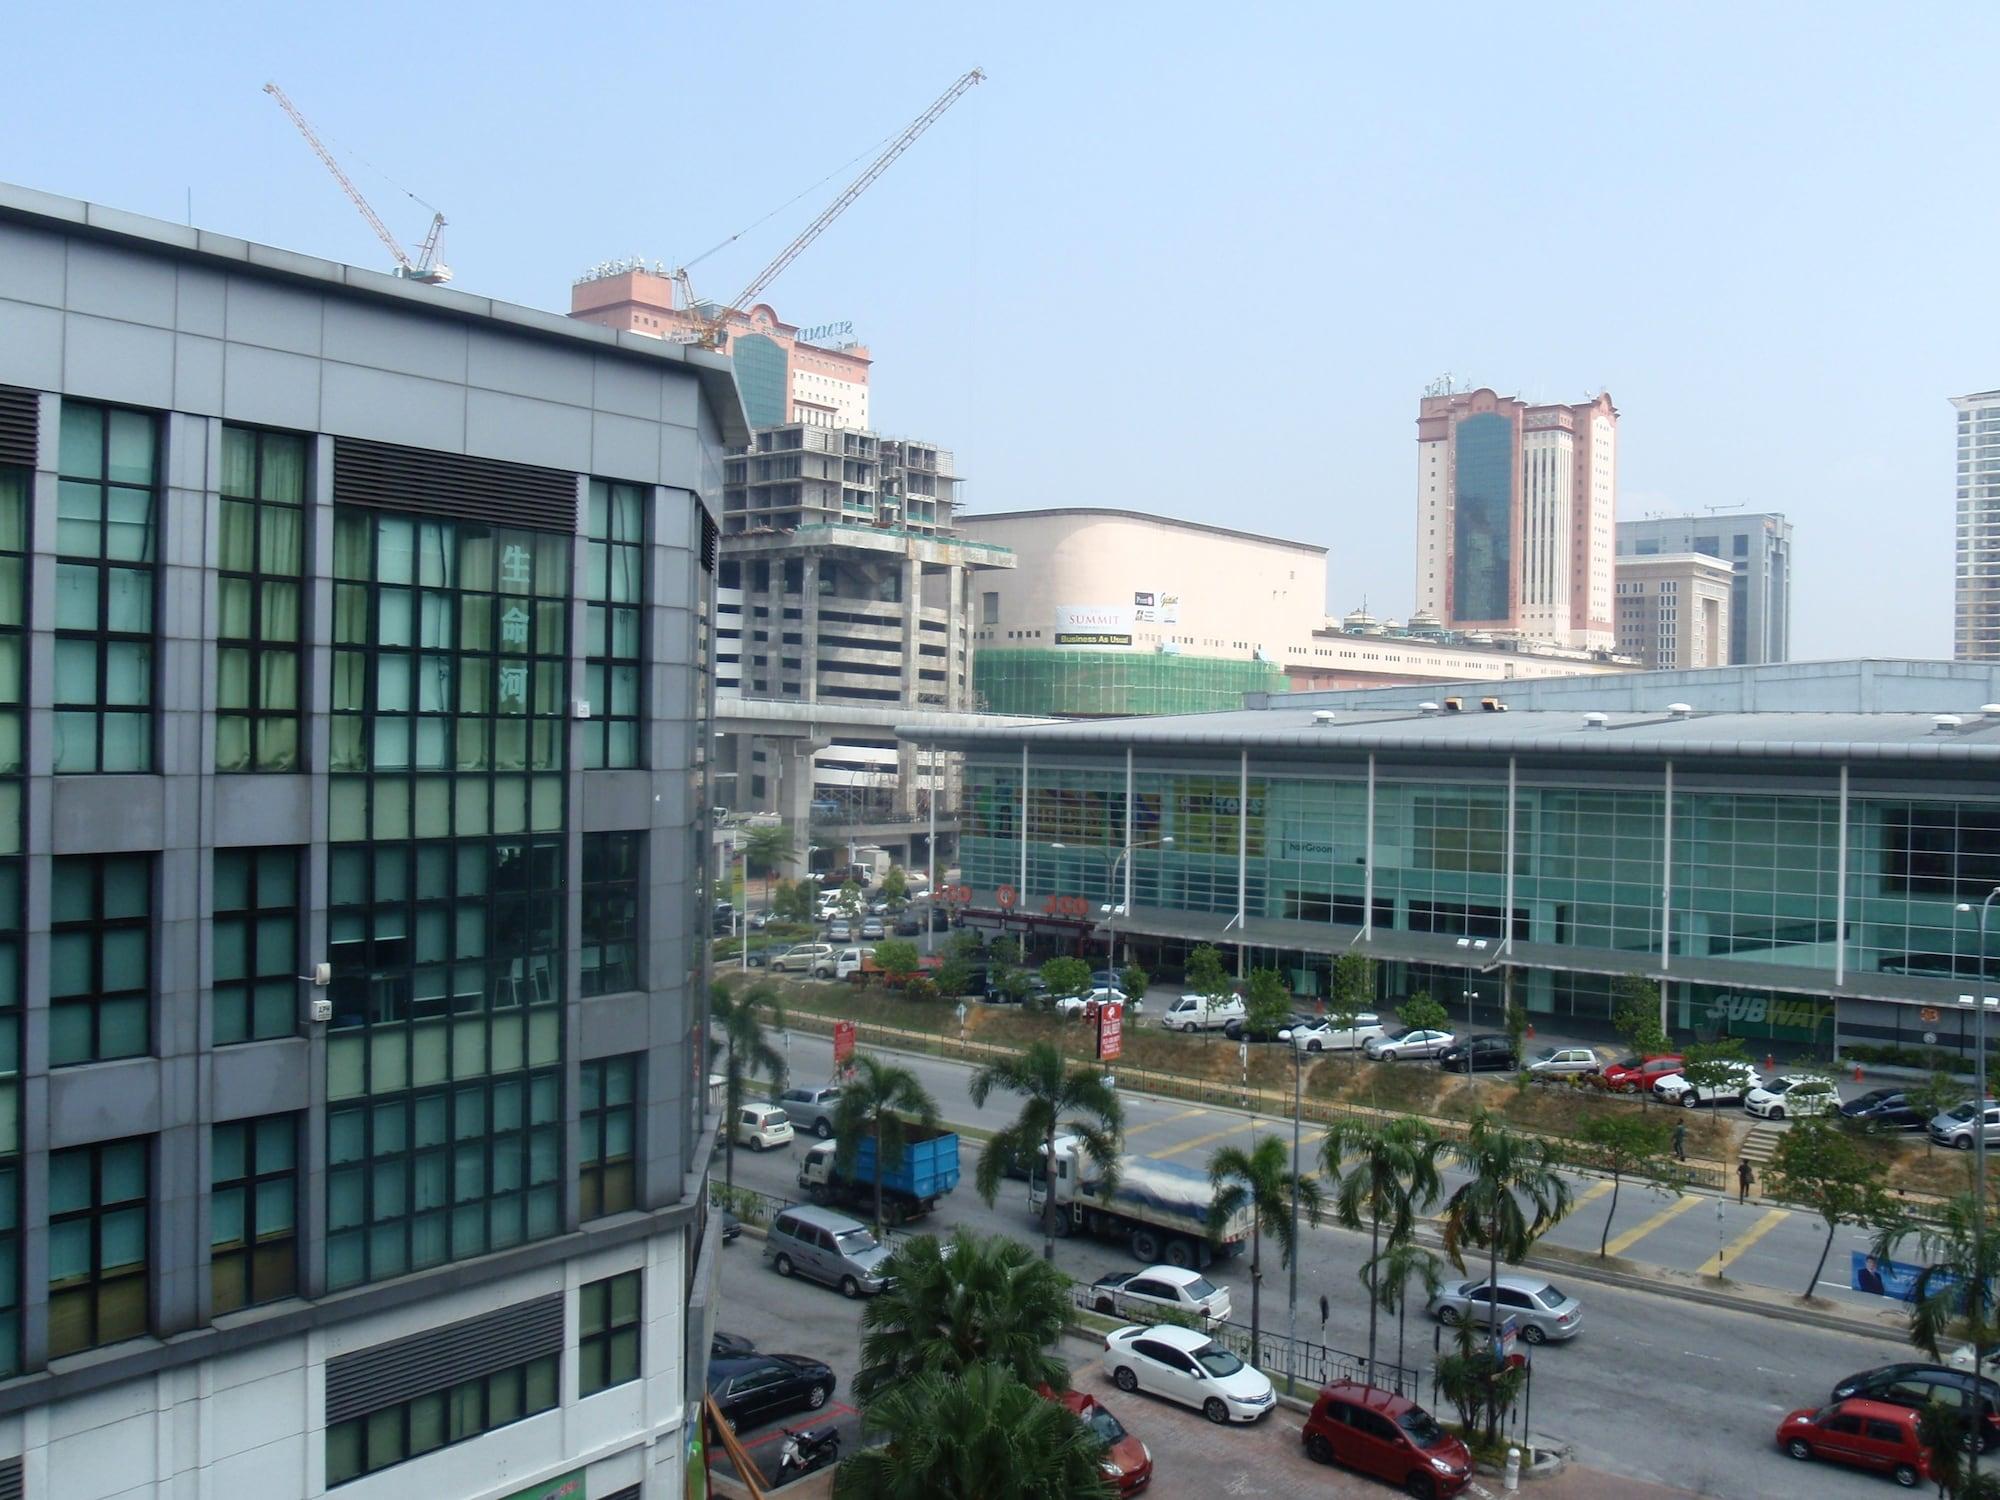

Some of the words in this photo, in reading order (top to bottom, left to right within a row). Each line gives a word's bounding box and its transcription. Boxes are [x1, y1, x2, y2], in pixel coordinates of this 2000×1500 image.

[500, 545, 531, 704] 生命河
[1069, 615, 1120, 625] SUMMIT
[1060, 635, 1097, 643] Business
[1098, 635, 1108, 644] As
[1705, 994, 1834, 1028] SUBWAY
